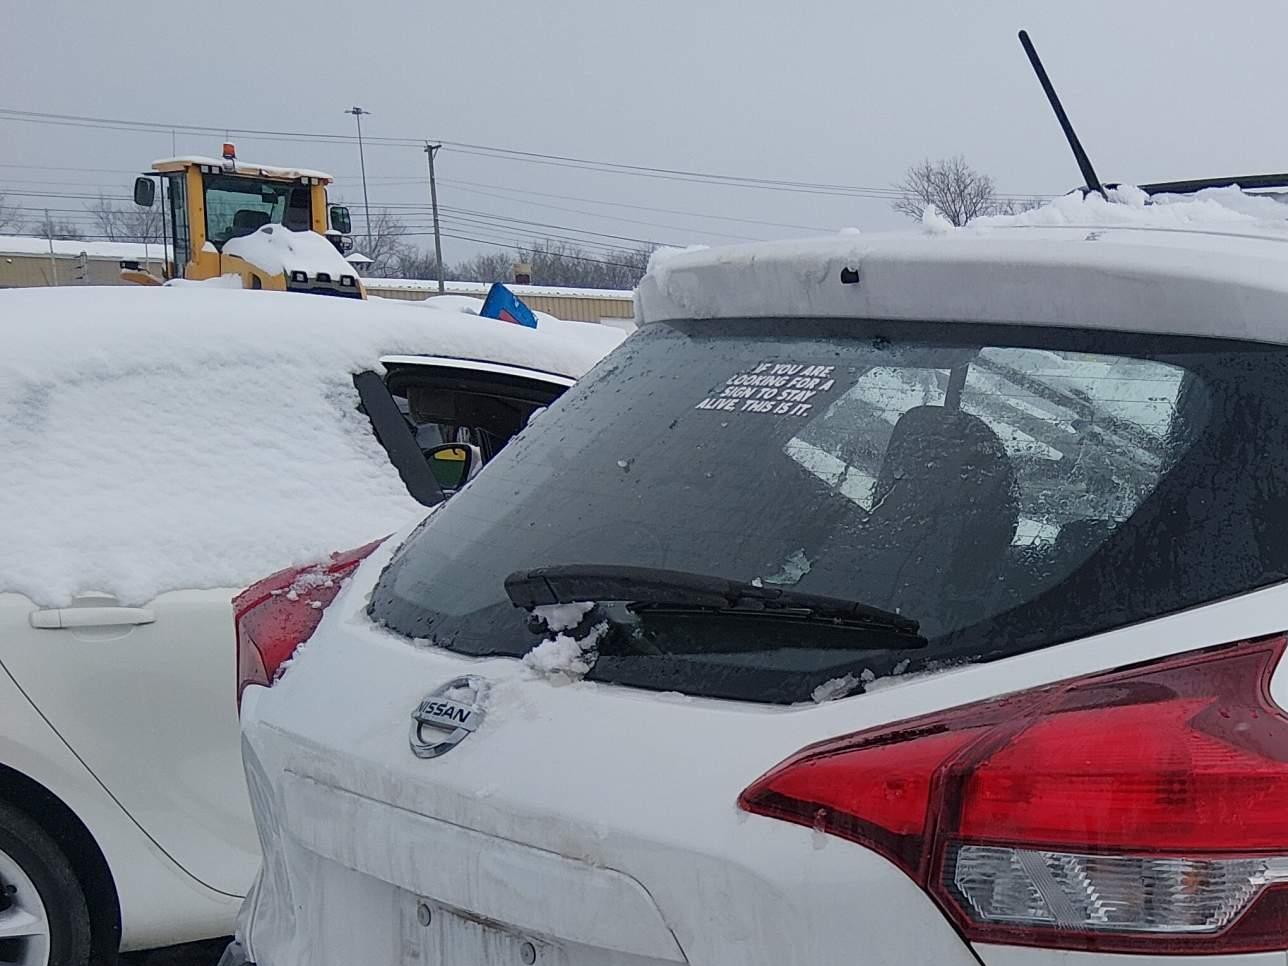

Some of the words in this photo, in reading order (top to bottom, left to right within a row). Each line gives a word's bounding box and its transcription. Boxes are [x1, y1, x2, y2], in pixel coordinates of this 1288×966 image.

[752, 363, 769, 374] IF
[770, 364, 802, 375] YOU
[803, 365, 834, 377] ARE
[726, 375, 789, 387] LOOKING
[786, 376, 819, 389] FOR
[819, 379, 835, 391] A
[720, 387, 757, 399] SIGN
[755, 388, 778, 399] TO
[776, 390, 816, 402] STAY
[695, 398, 738, 411] ALIVE,
[740, 400, 774, 413] THIS
[775, 403, 791, 415] IS
[791, 404, 813, 417] IT.
[417, 701, 471, 723] NISSAN
